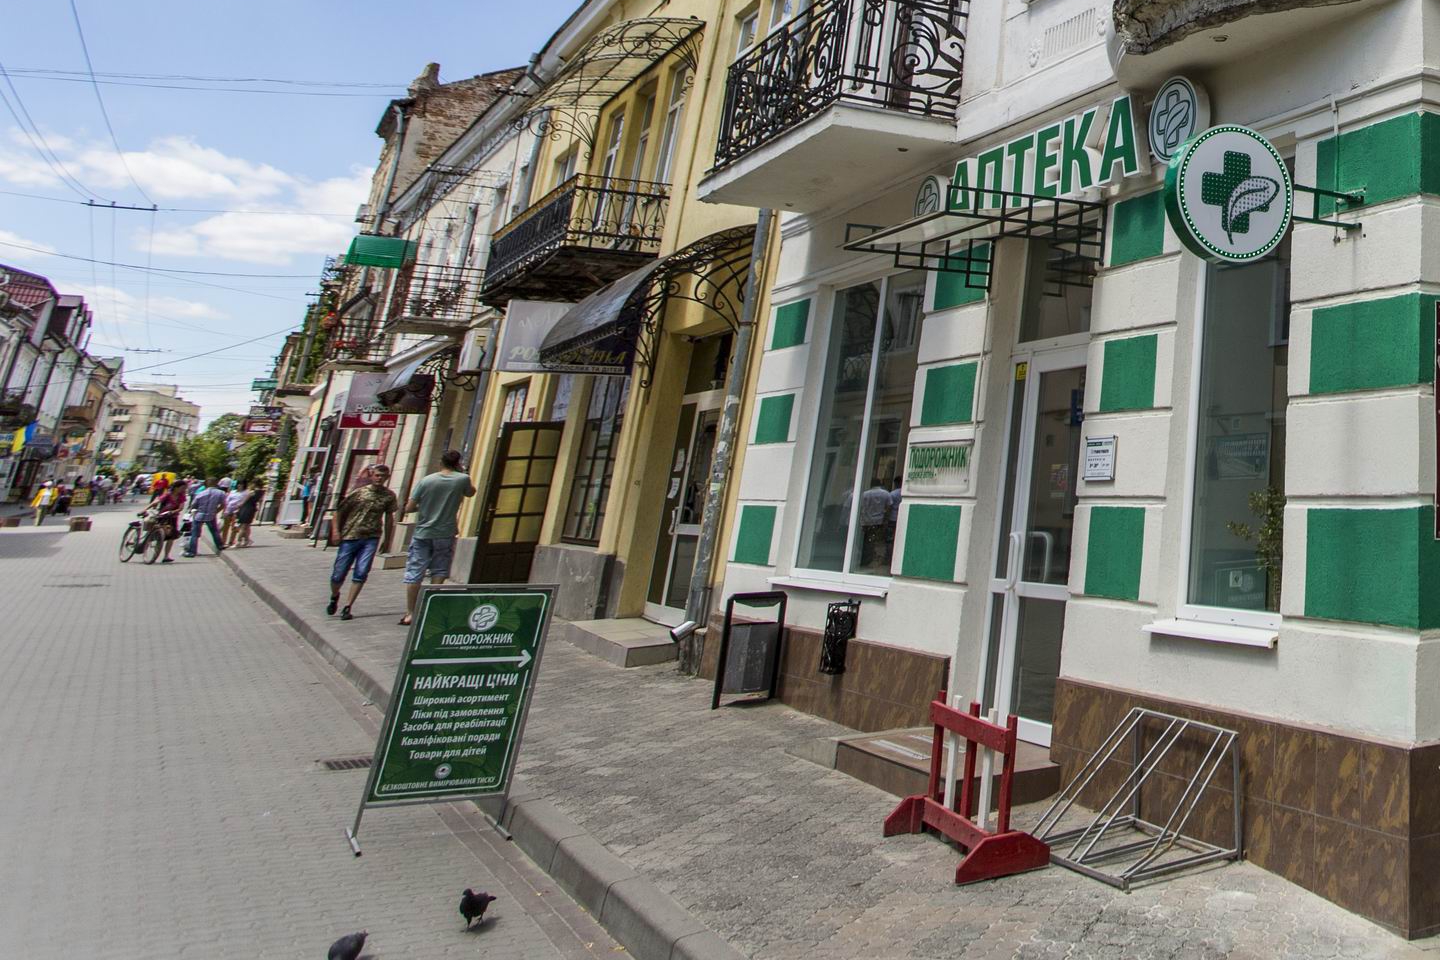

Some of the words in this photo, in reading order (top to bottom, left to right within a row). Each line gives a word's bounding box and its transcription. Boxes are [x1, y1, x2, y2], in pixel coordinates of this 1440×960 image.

[950, 94, 1139, 210] АПТЕКА
[909, 447, 967, 468] ПОДОРОЖНИК
[441, 633, 514, 645] ПОДОРОЖНИК
[413, 674, 485, 690] НАЙКРАЩІ
[486, 673, 518, 688] ЦІНИ
[413, 695, 456, 707] Широкий
[457, 694, 509, 704] асортимент
[411, 710, 432, 719] Ліки
[433, 709, 448, 719] під
[449, 707, 504, 718] замовлення
[401, 722, 433, 732] Засоби
[434, 723, 452, 731] для
[453, 717, 508, 730] реабілітації
[401, 734, 467, 746] Кваліфіковані
[468, 733, 501, 743] поради
[409, 750, 441, 760] Товари
[442, 750, 460, 759] для
[462, 746, 487, 757] дітей
[381, 781, 428, 791] БЕЗКОШТОВНЕ
[429, 778, 476, 787] ВИМІРЮВАННЯ
[477, 776, 496, 784] ТИСКУ
